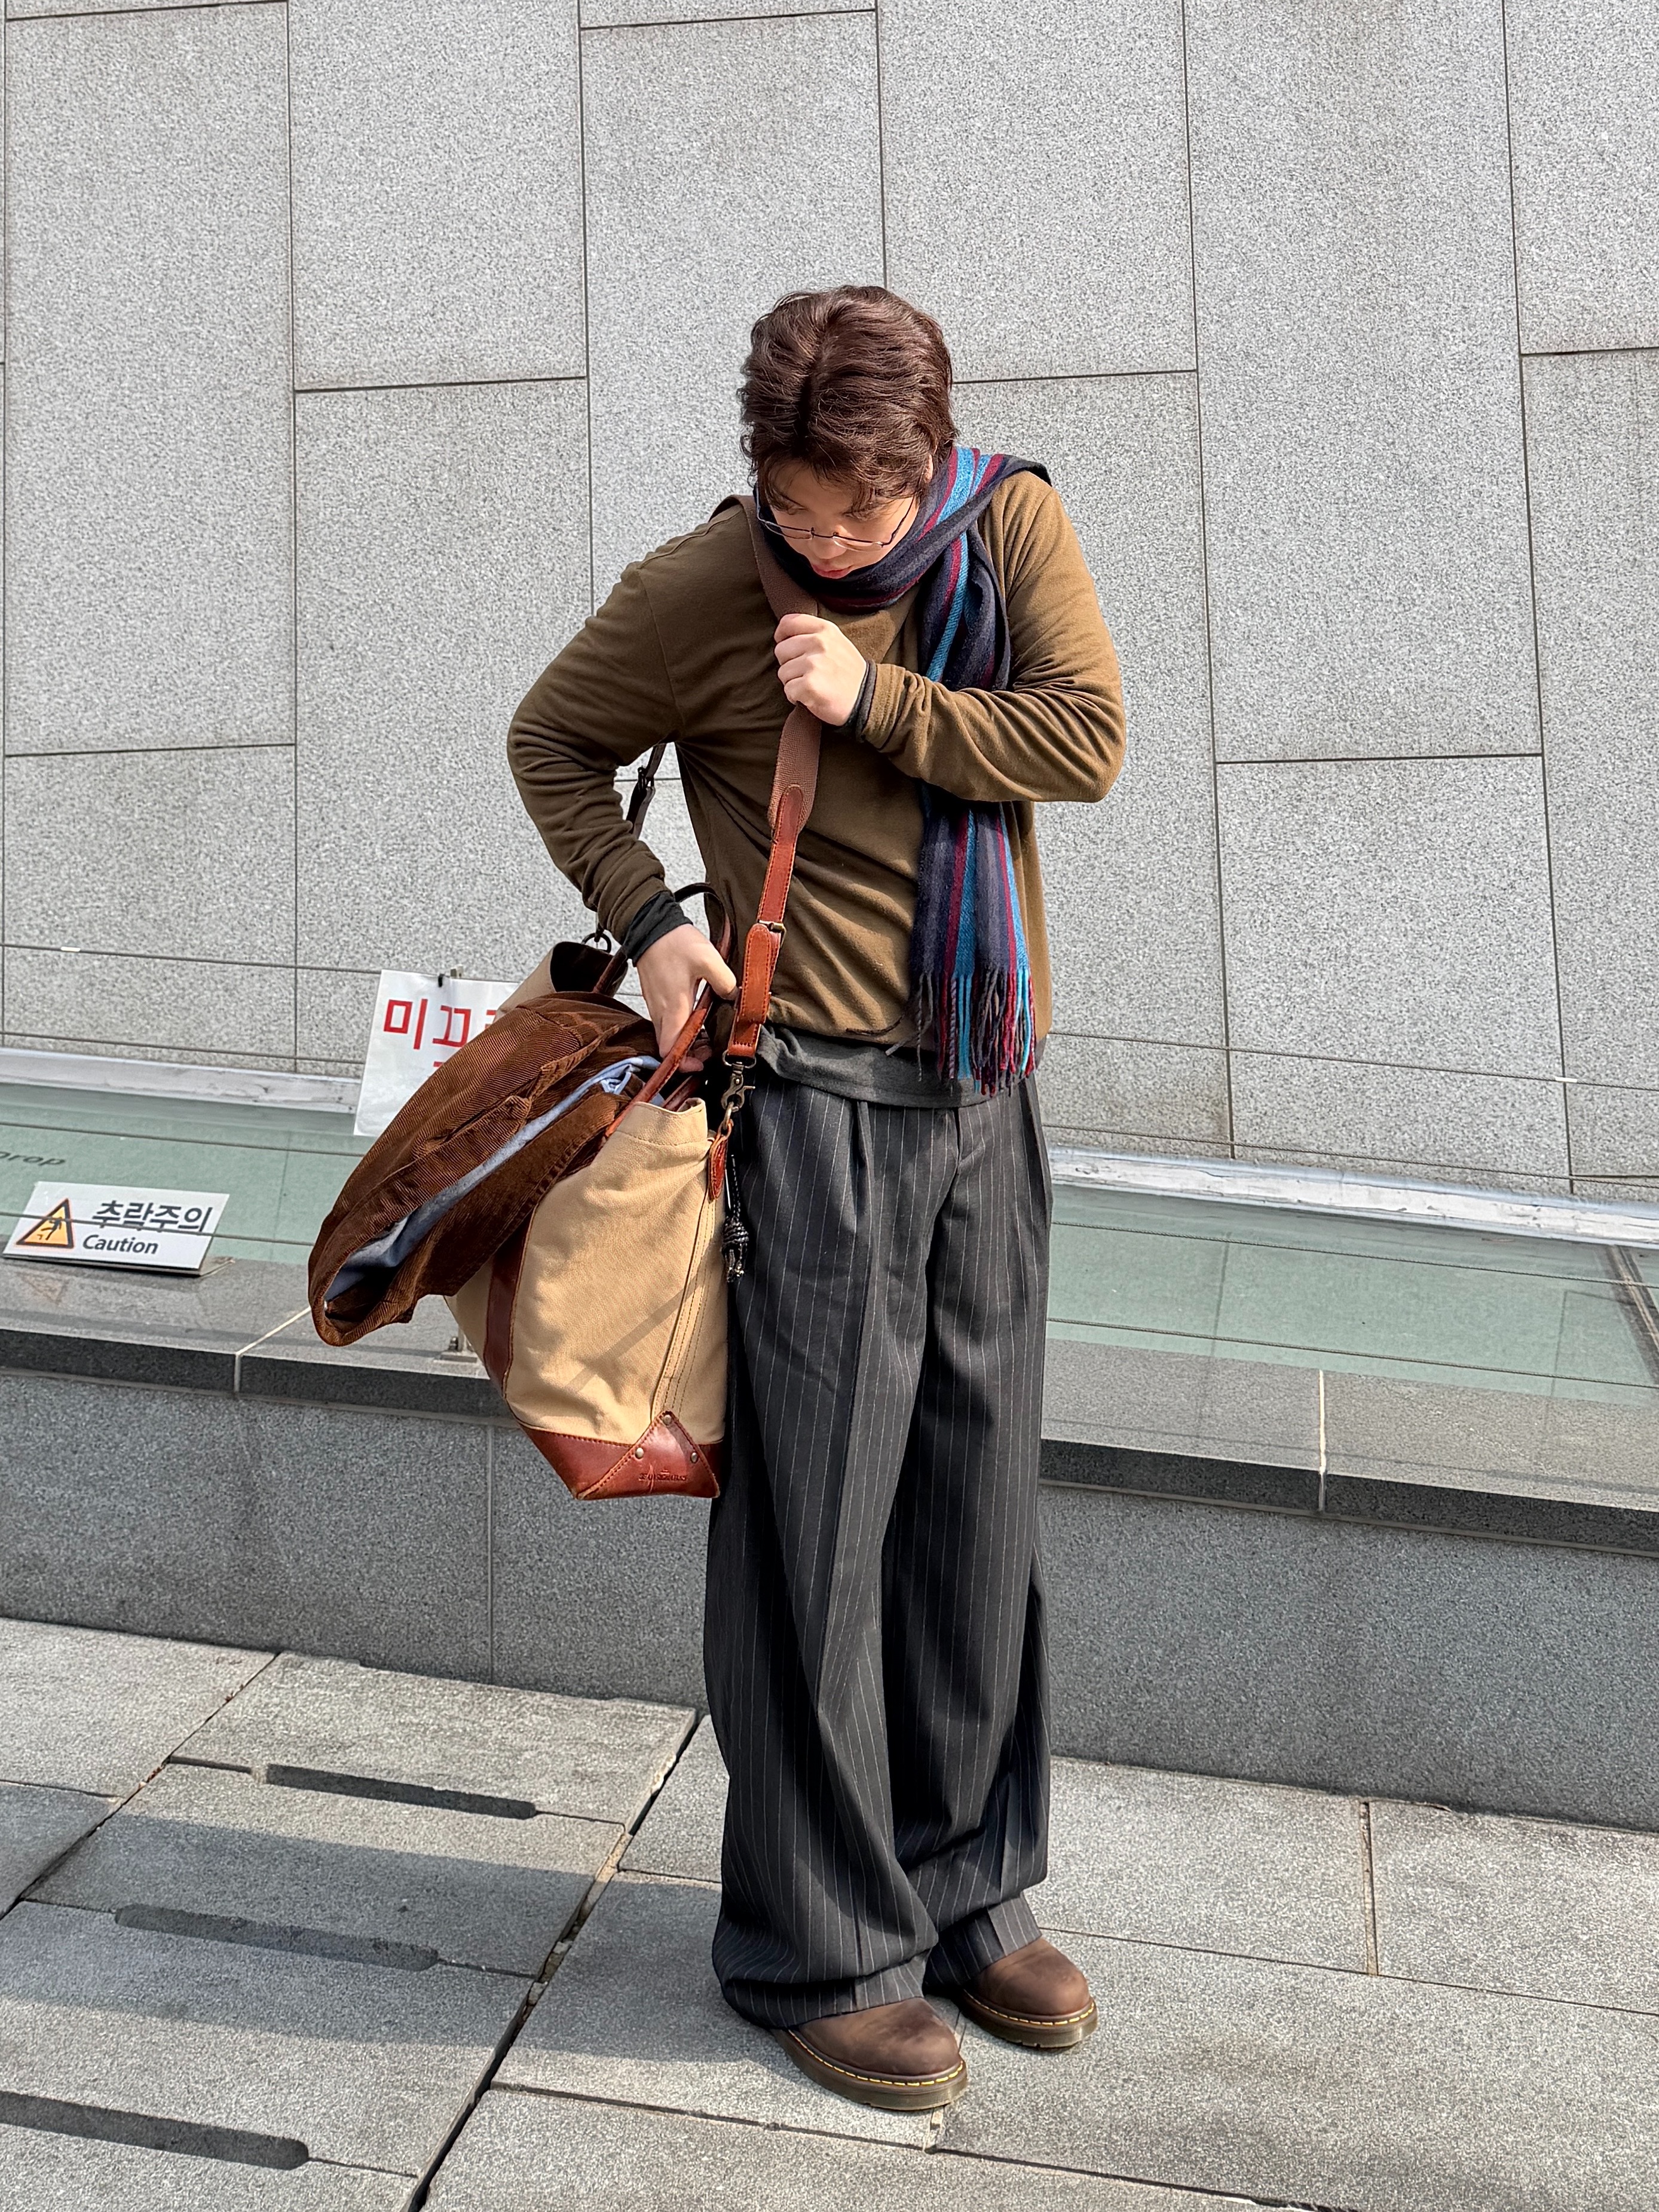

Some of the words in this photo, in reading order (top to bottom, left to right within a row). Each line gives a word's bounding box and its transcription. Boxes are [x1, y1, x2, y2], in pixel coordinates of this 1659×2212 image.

[384, 999, 497, 1050] 미끄
[92, 1200, 213, 1232] 추락주의
[82, 1234, 158, 1255] Caution
